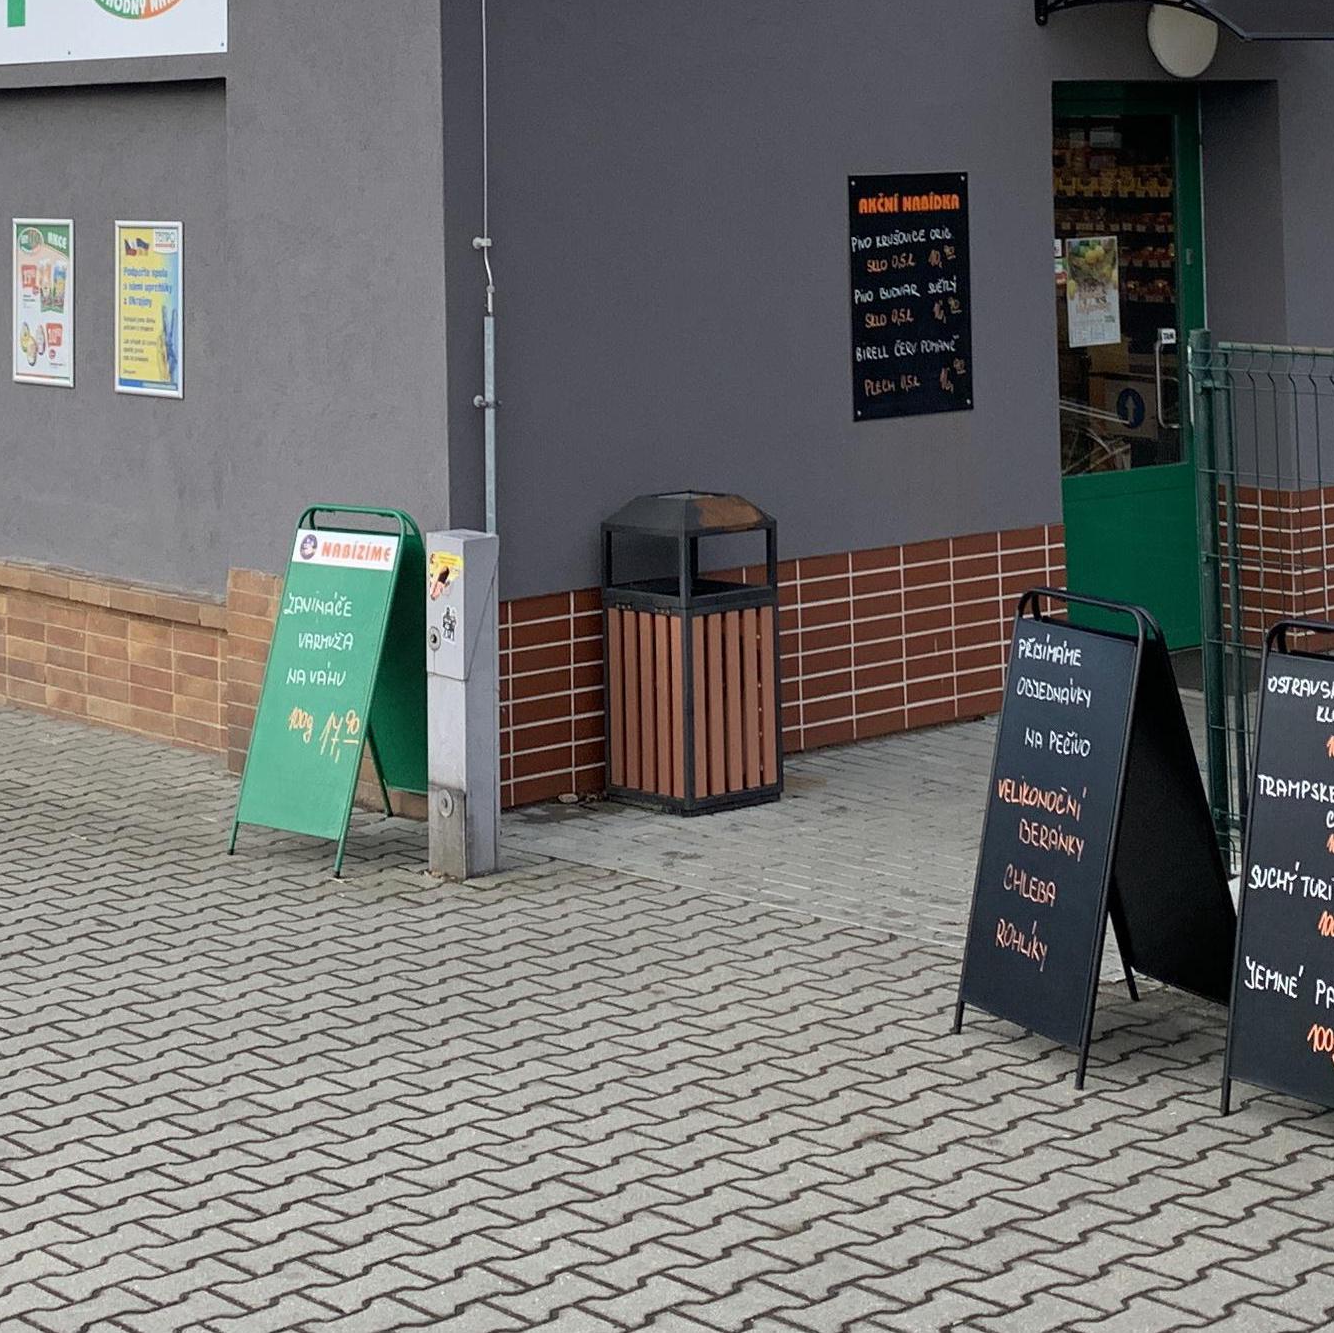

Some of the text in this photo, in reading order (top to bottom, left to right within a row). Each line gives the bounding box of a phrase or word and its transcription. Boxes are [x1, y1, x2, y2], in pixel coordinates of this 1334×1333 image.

[858, 191, 960, 214] AKČNÍ NABÍDKA
[856, 344, 890, 362] BIRELL
[321, 541, 392, 563] NABÍZÍME
[283, 591, 352, 617] ZAVINÁČE
[286, 661, 347, 687] NA VÁHU
[1016, 676, 1092, 708] OBJEDNÁVKY
[1024, 727, 1091, 757] NA PEČIVO
[997, 775, 1087, 821] VELIKONOČNÍ
[1018, 818, 1085, 862] BERÁNKY
[1003, 863, 1057, 907] CHLEBA
[1248, 861, 1300, 895] SUCHÝ
[995, 918, 1048, 973] ROHLÍKY
[1244, 955, 1305, 999] JEMNÉ
